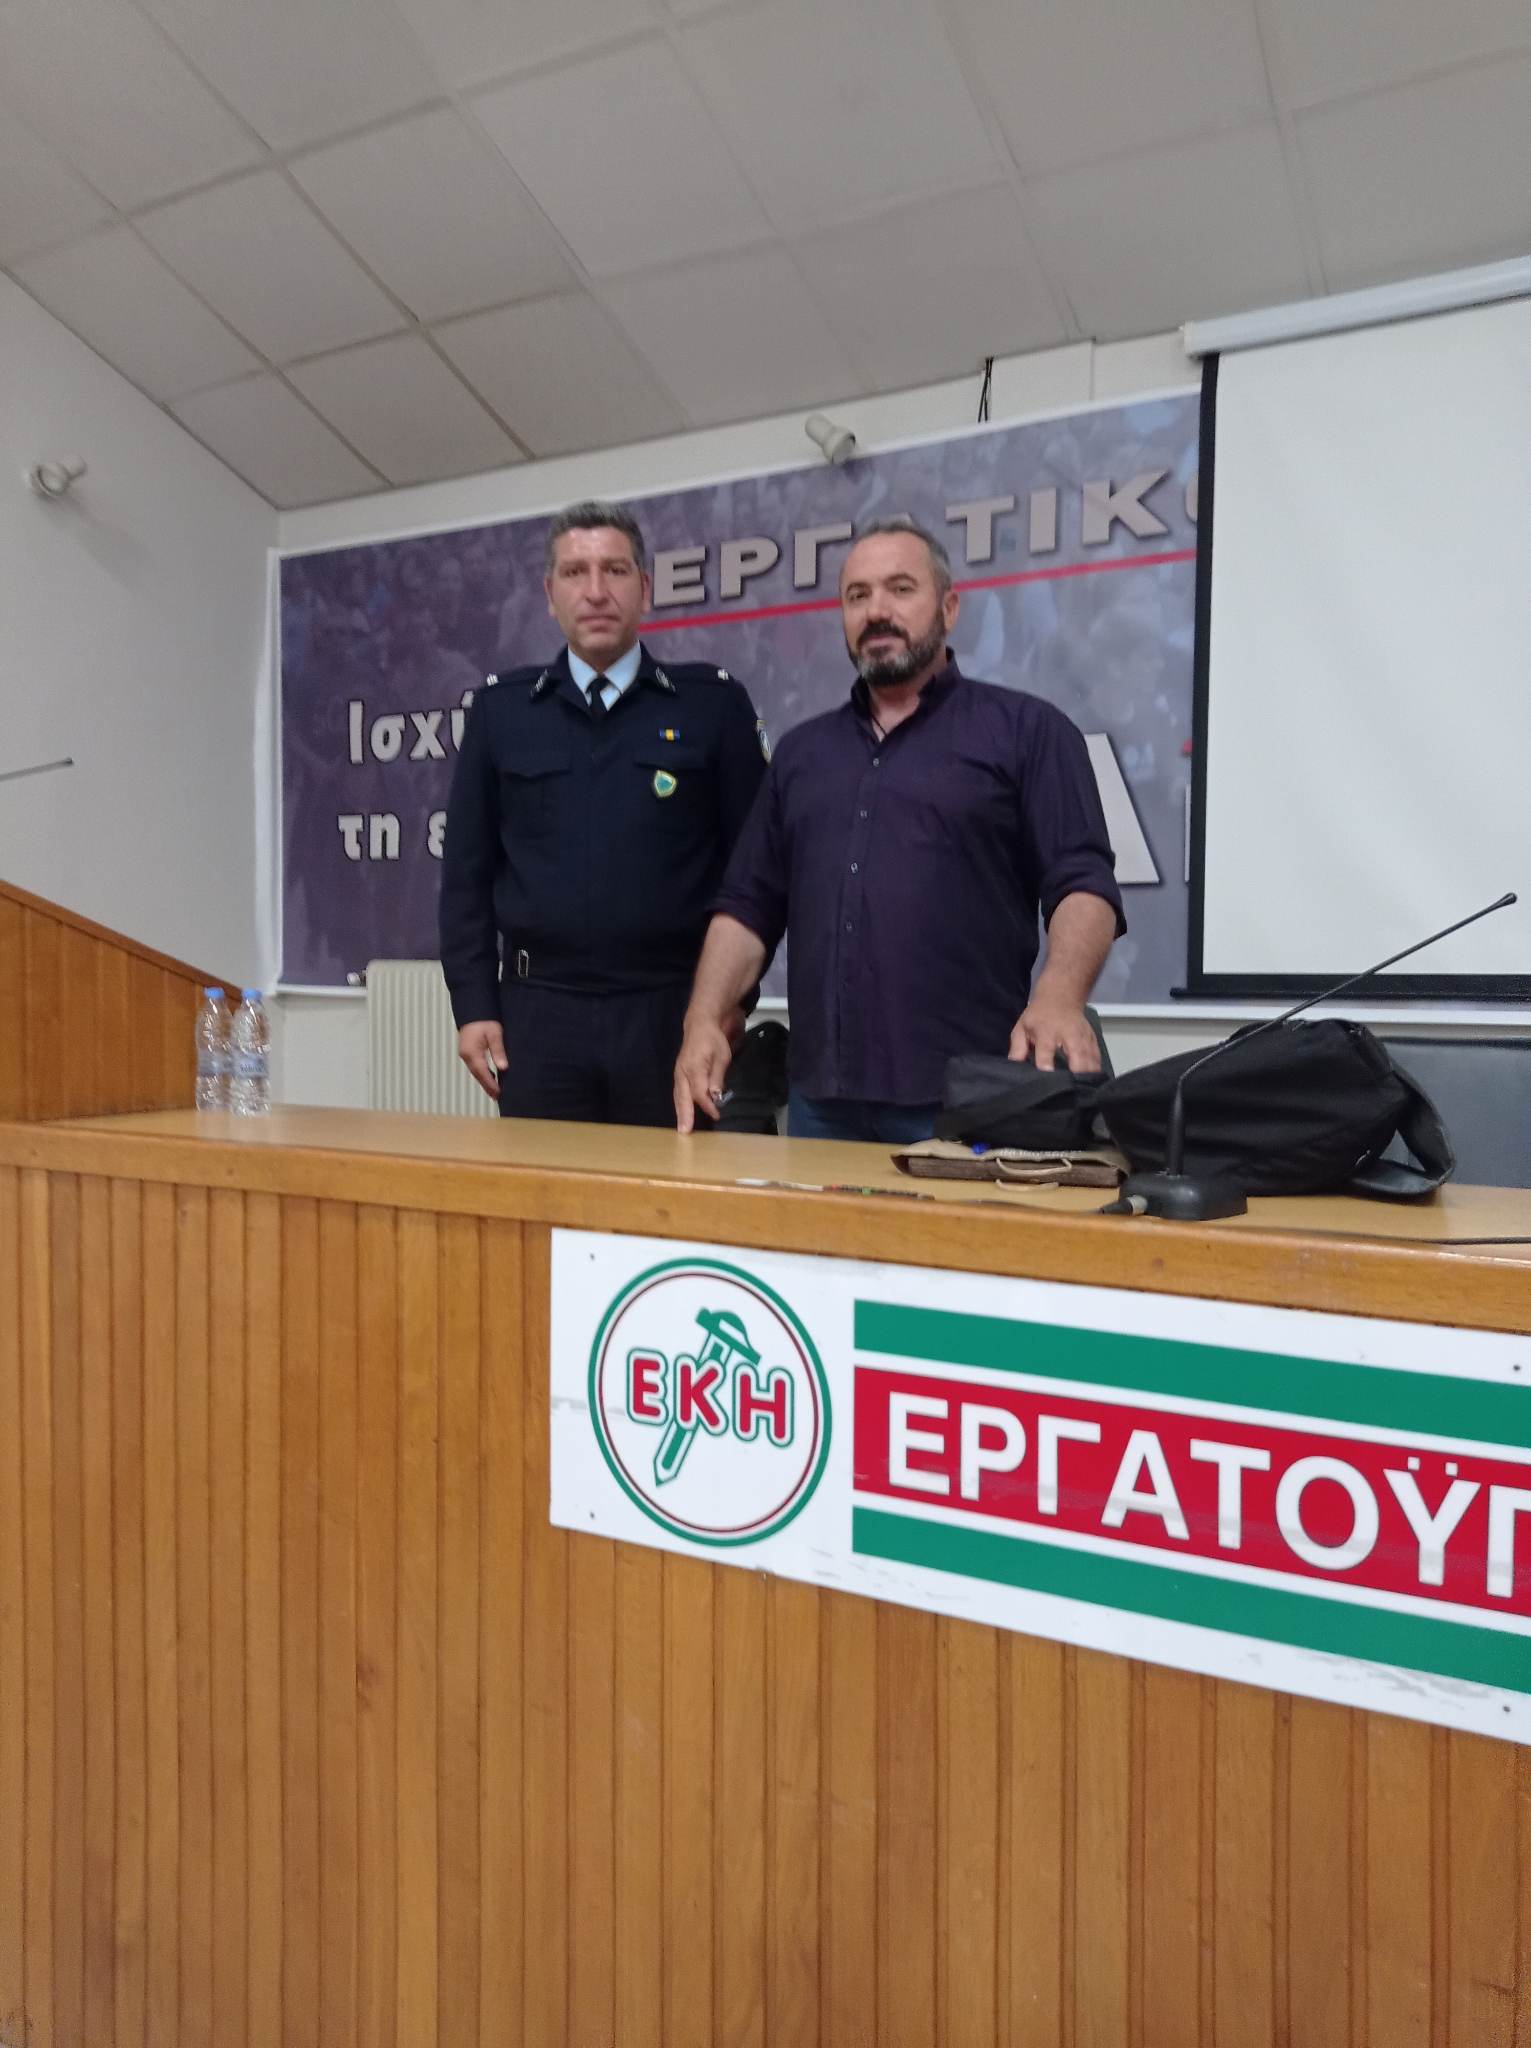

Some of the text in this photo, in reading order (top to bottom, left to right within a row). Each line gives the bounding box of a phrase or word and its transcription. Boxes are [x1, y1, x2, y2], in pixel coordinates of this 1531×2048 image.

[653, 468, 1198, 607] ΕΡΓΤΙΚ
[337, 811, 401, 862] τη
[630, 1353, 790, 1443] ΕΚΗ
